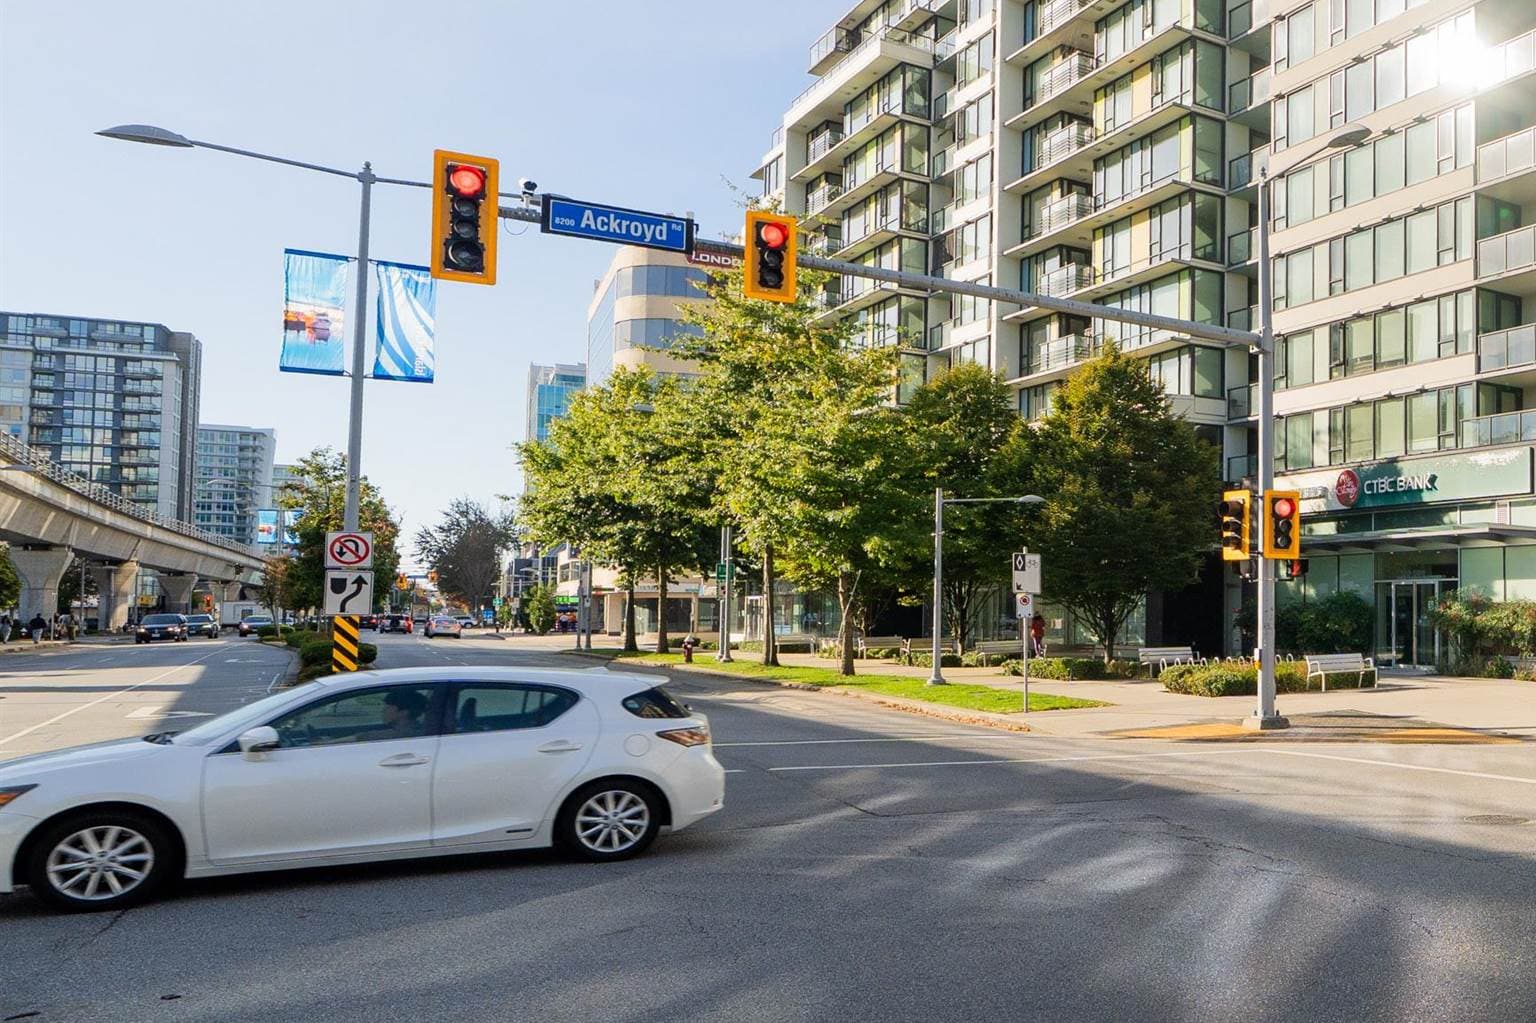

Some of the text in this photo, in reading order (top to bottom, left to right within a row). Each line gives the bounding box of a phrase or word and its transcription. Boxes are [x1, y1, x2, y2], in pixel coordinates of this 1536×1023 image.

[554, 209, 682, 242] 8200 Ackroyd Rd
[691, 250, 742, 266] LONDO
[1363, 476, 1394, 495] CTBC
[1396, 474, 1433, 492] BANK
